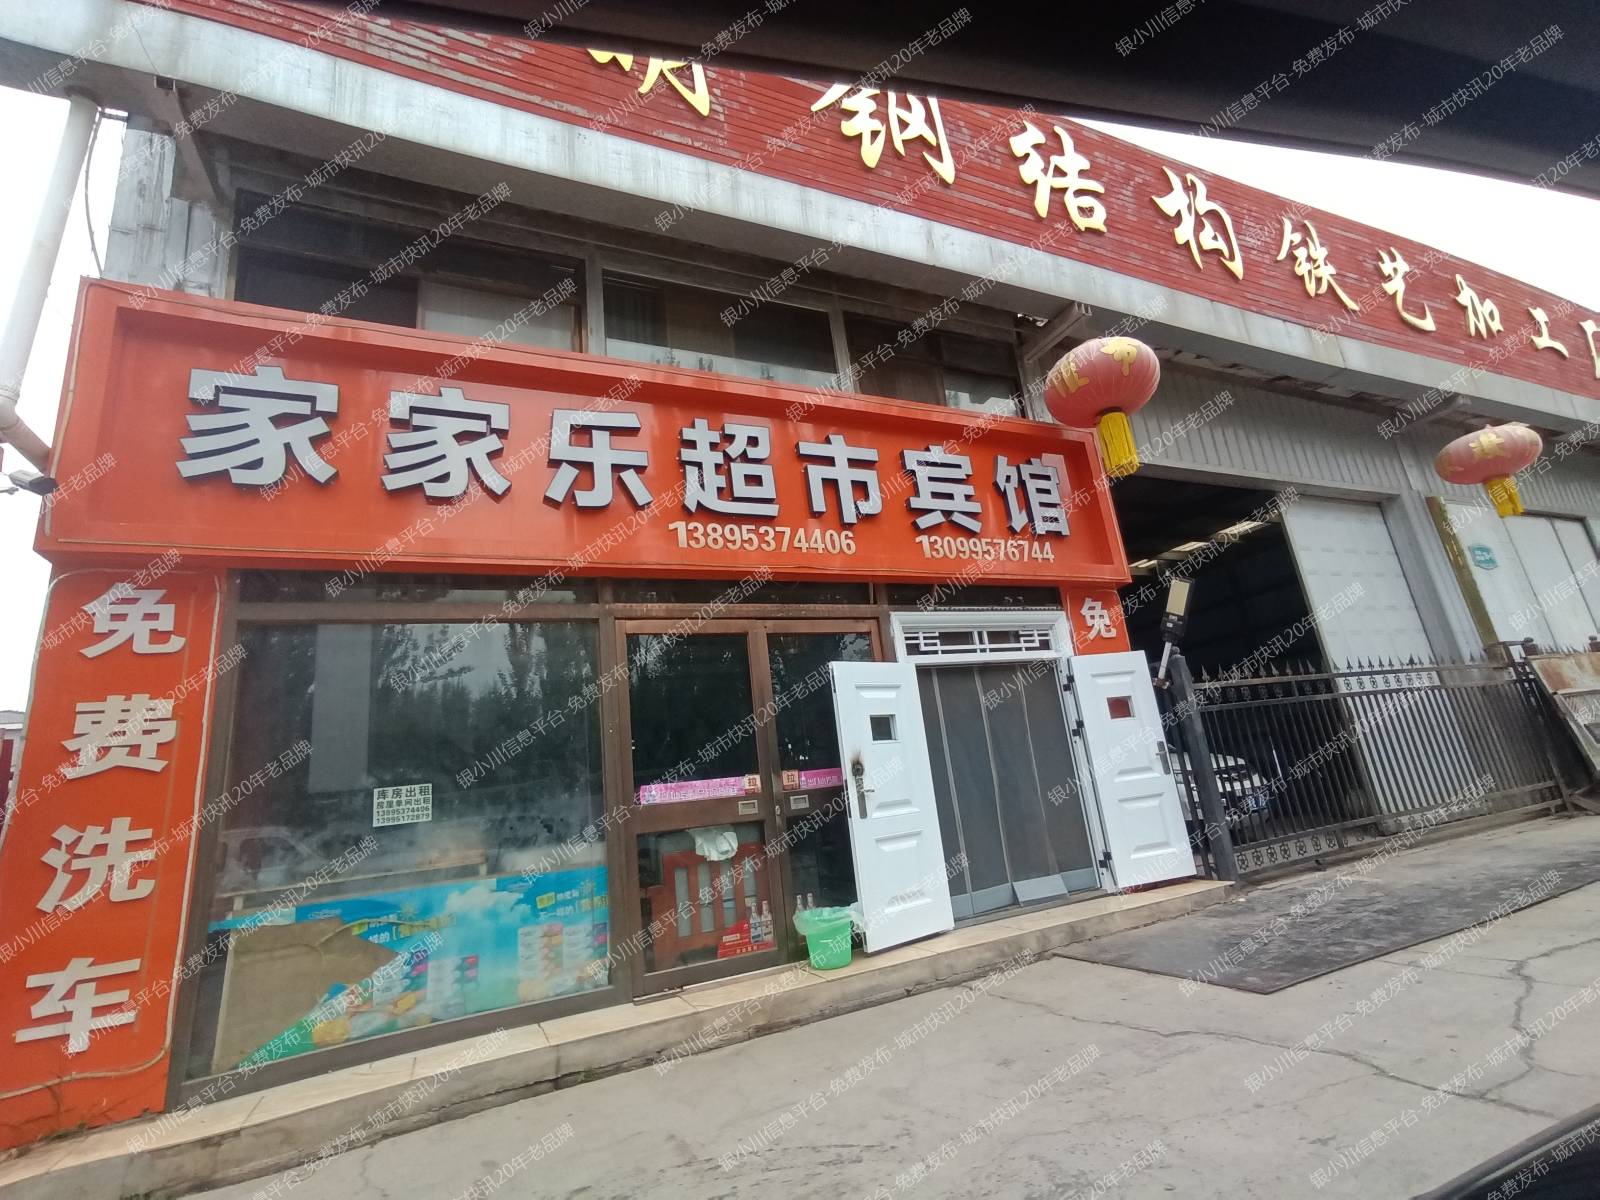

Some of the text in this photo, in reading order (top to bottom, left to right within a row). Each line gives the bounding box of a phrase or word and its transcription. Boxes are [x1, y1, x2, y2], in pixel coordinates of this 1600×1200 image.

[175, 365, 1070, 537] 家家乐超市宾馆
[668, 520, 857, 555] 13895374406
[915, 534, 1055, 563] 13099576744
[1079, 596, 1117, 642] 免
[376, 785, 431, 800] 库房出租
[15, 582, 187, 1054] 免费洗车
